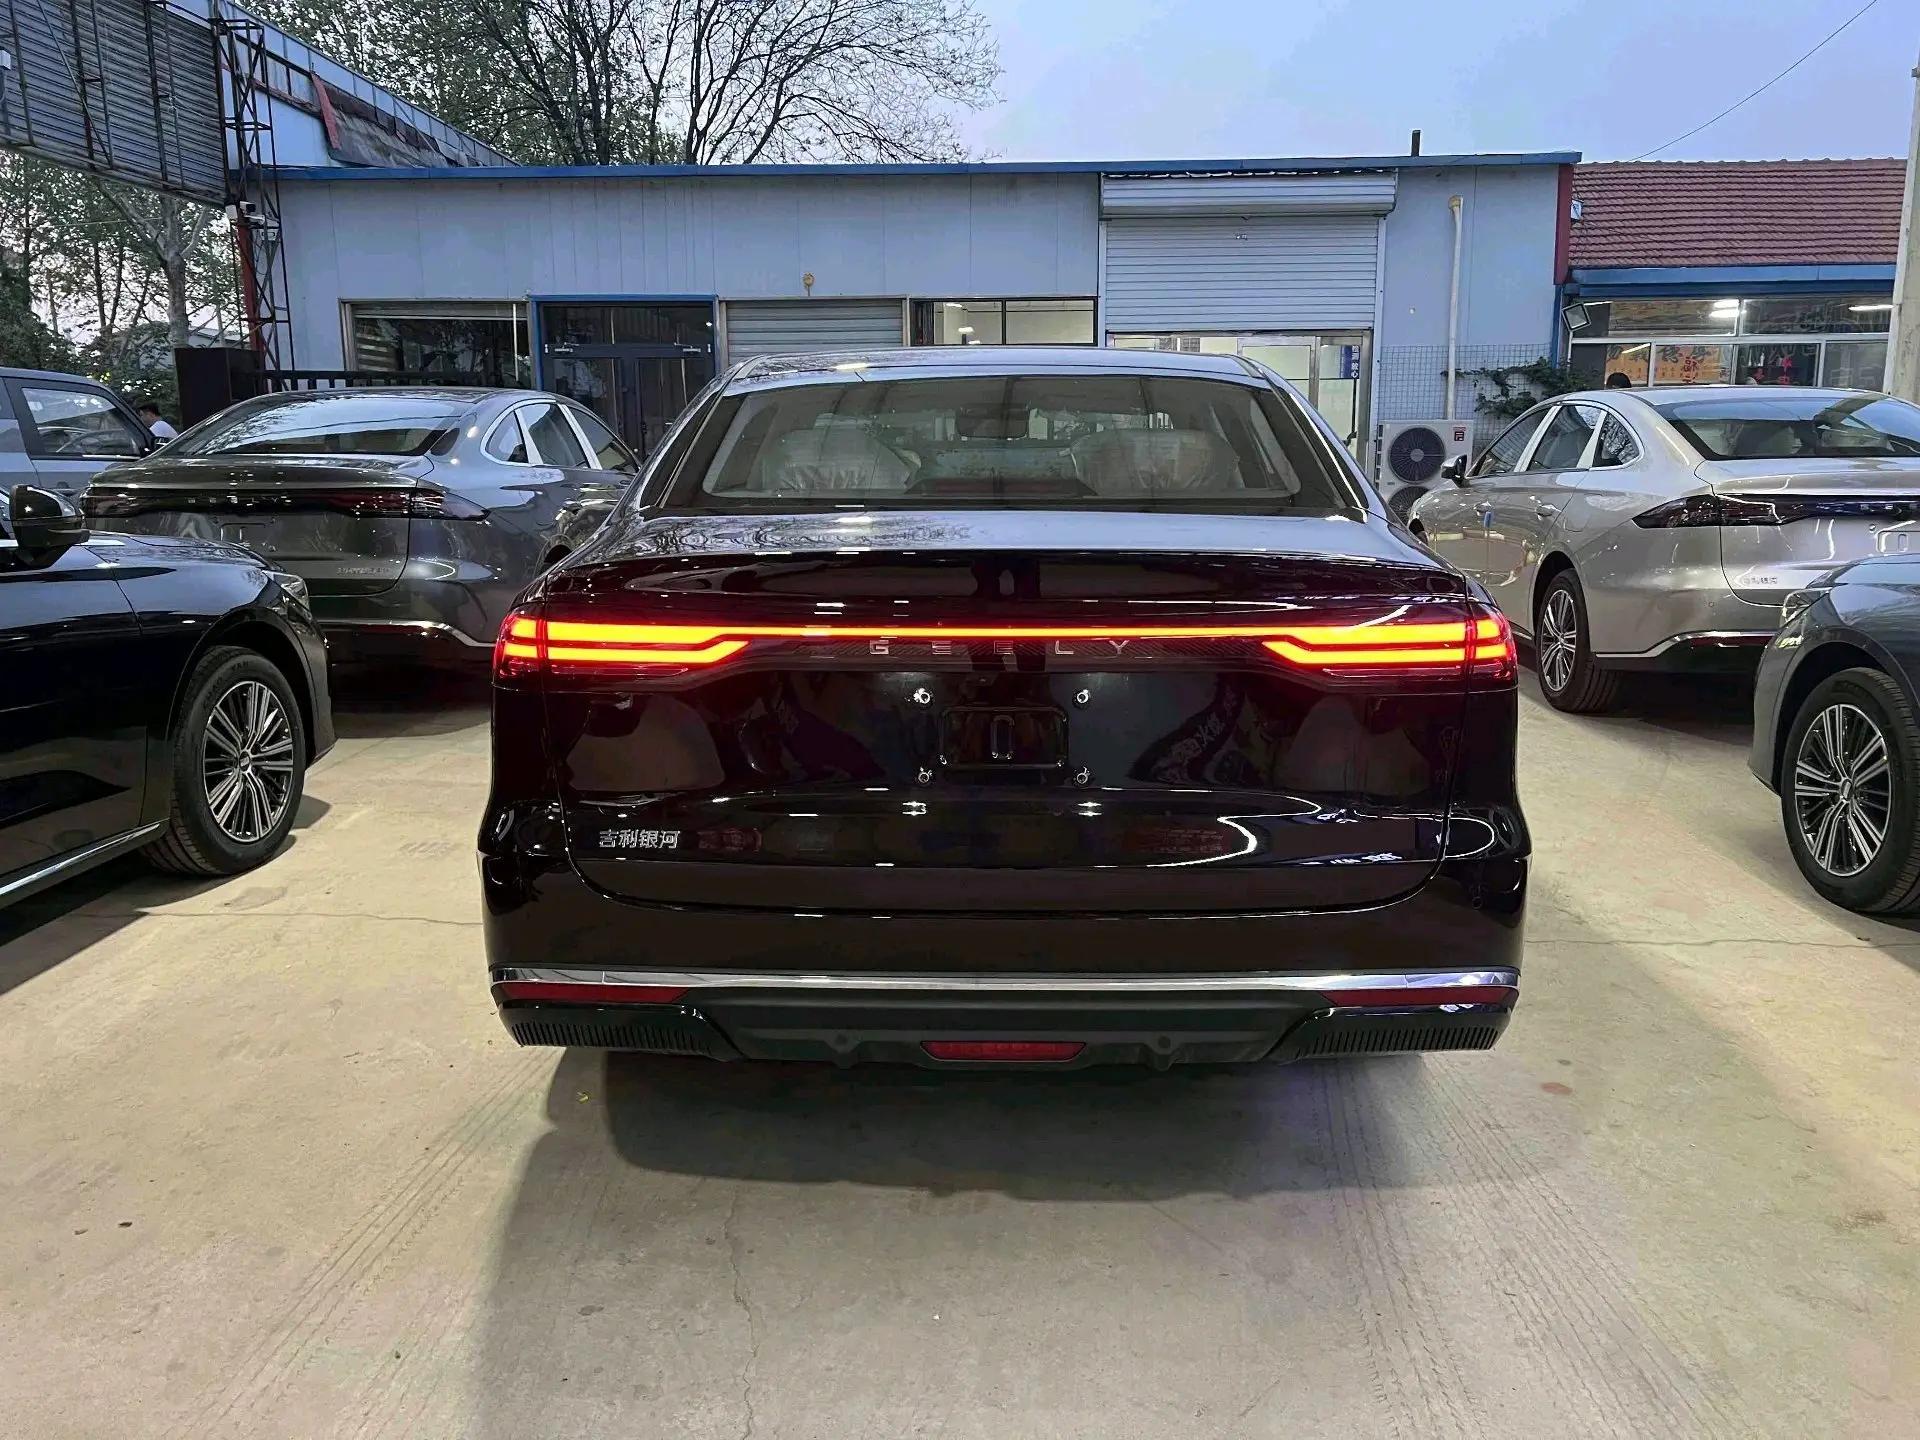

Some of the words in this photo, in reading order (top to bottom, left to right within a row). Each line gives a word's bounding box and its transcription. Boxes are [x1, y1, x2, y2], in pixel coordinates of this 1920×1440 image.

[869, 640, 1130, 655] GEELY
[599, 828, 681, 849] 吉利银河
